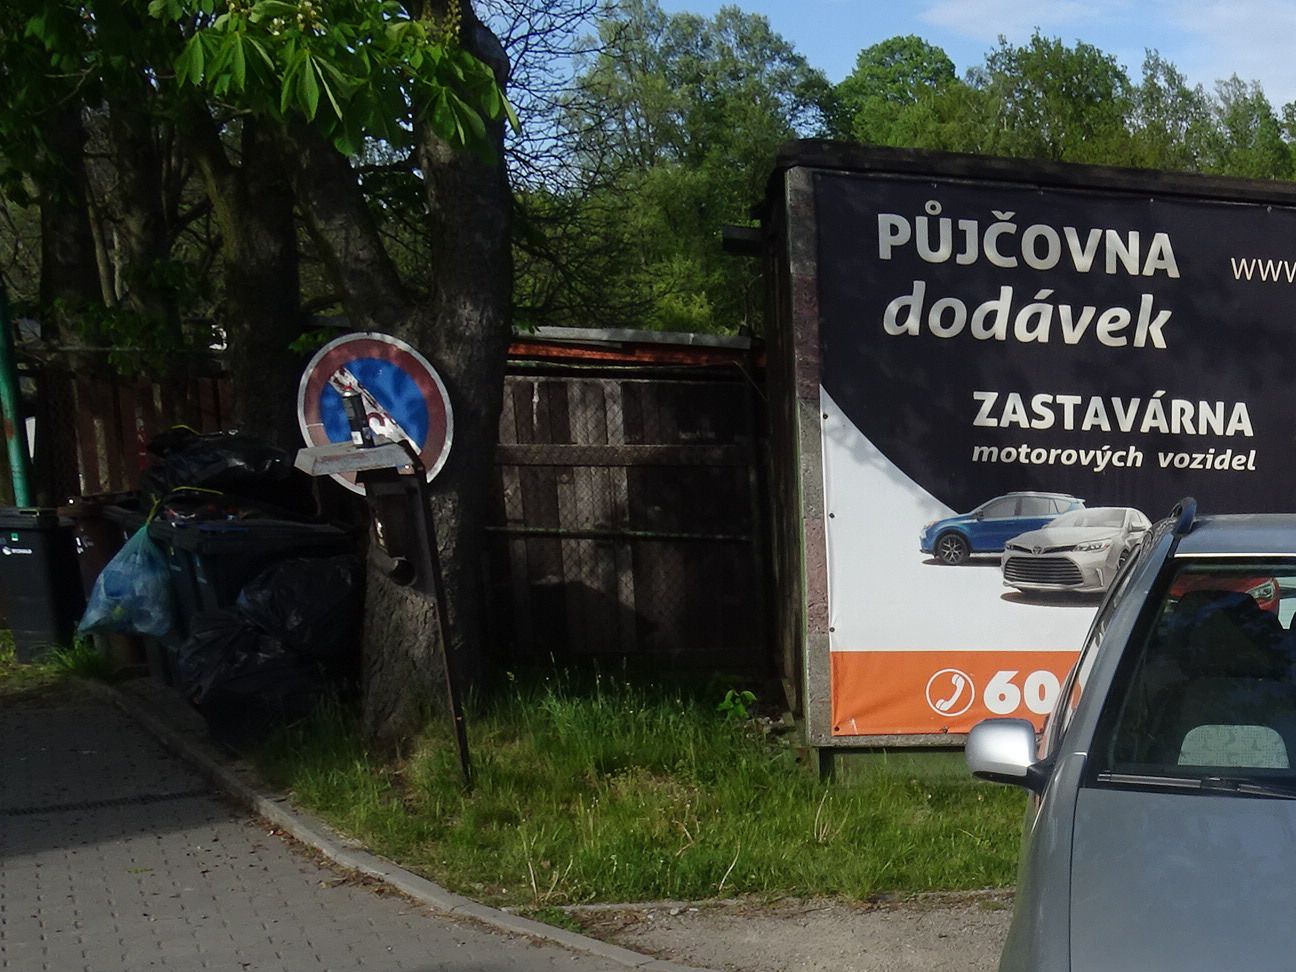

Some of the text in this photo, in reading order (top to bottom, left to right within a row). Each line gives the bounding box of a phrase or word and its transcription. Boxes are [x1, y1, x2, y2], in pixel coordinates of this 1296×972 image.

[877, 199, 1181, 279] PŮJČOVNA
[883, 280, 1173, 349] dodávek
[972, 390, 1254, 437] ZASTAVÁRNA
[972, 444, 1257, 472] motorových vozidel
[983, 670, 1062, 715] 60
